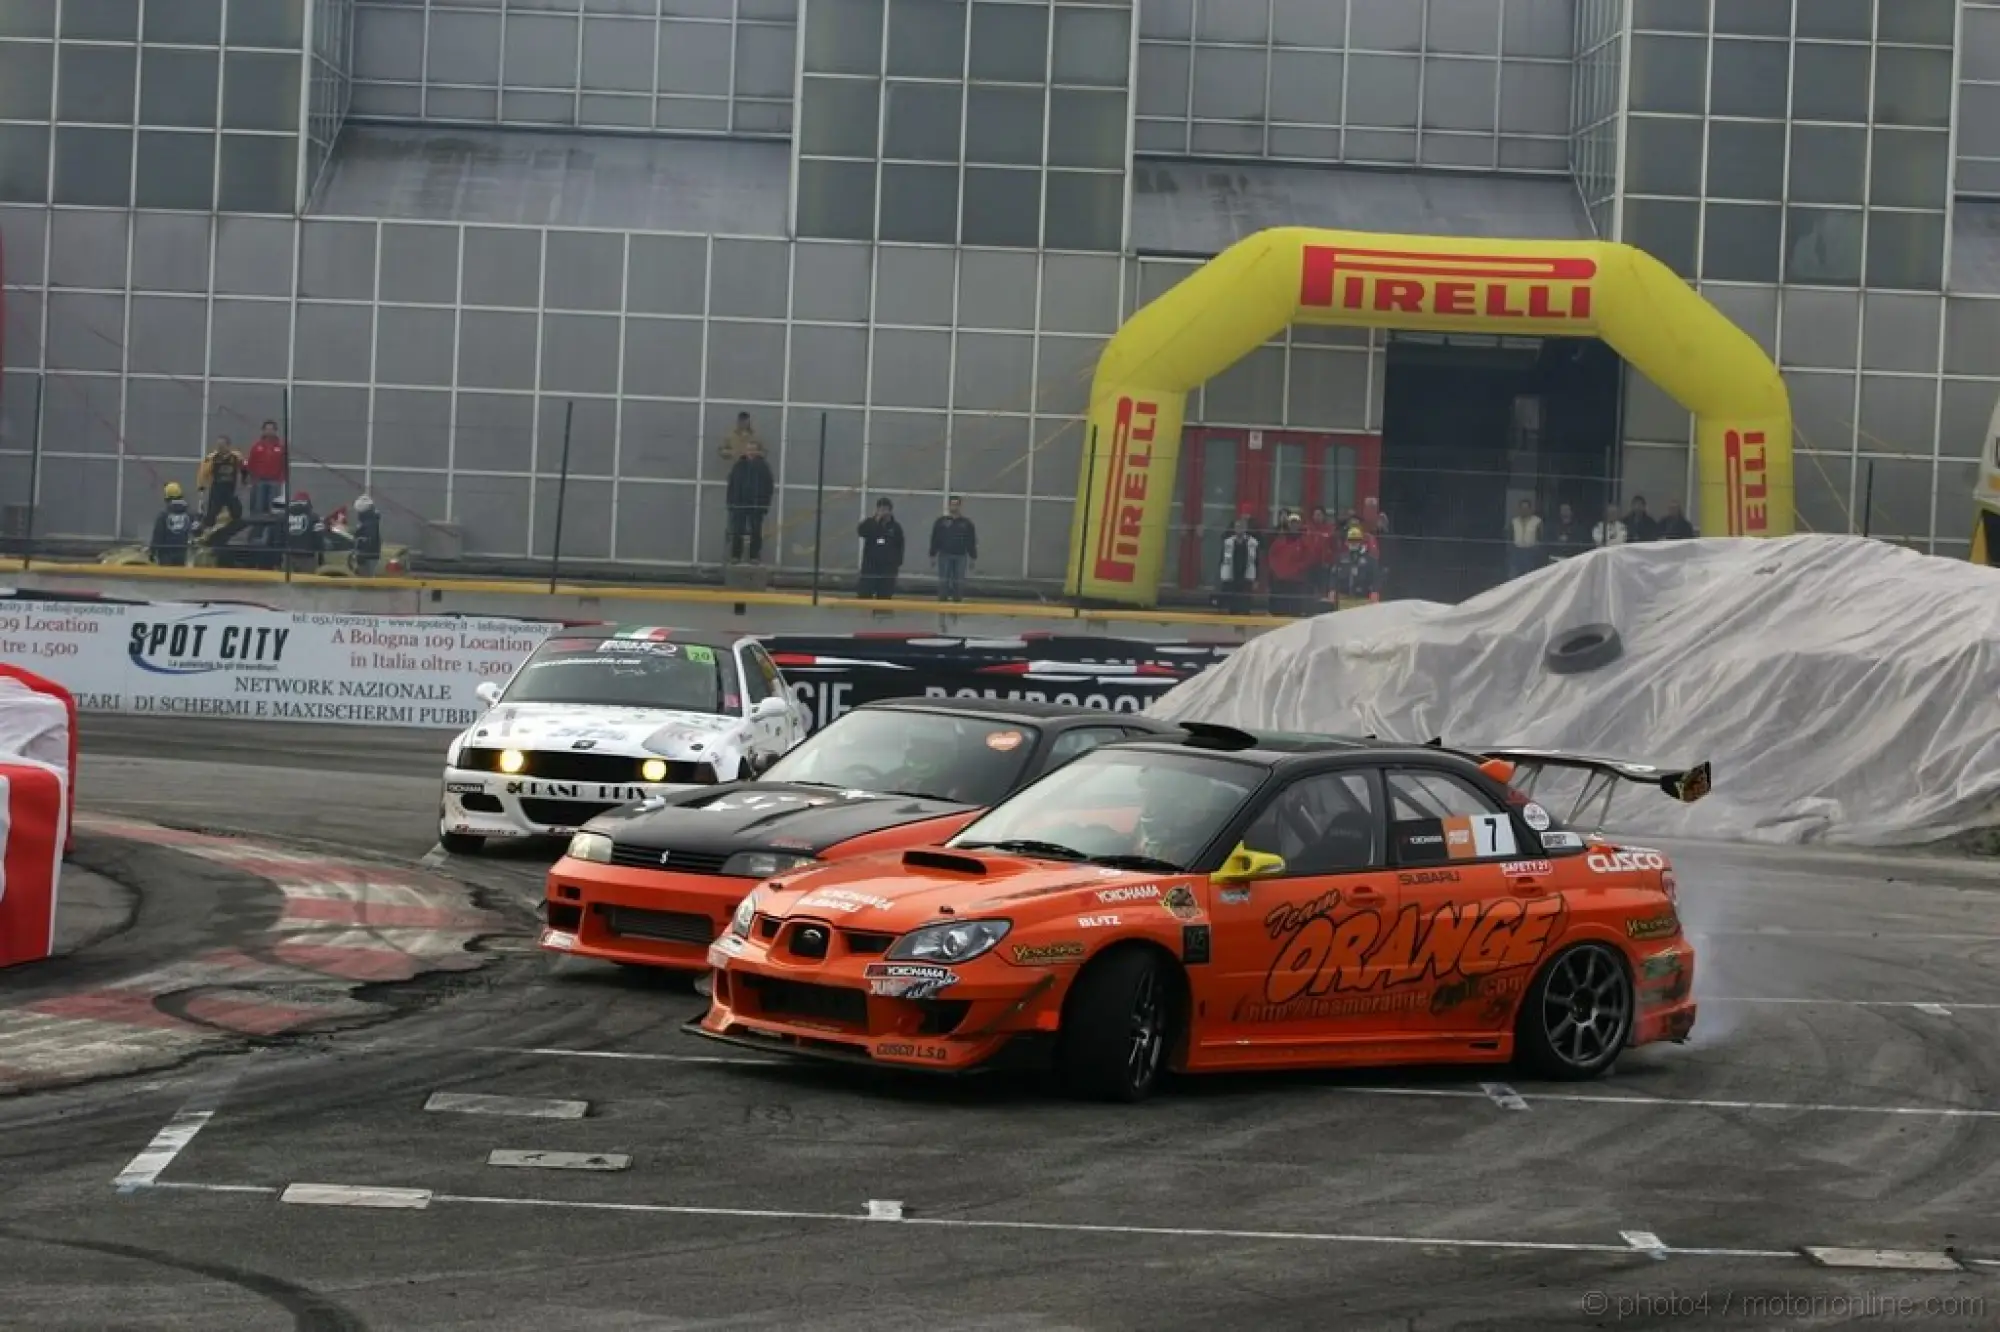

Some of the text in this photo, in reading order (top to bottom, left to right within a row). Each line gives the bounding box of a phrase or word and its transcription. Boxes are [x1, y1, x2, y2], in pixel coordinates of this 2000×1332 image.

[1301, 244, 1597, 319] PIRELLI
[1094, 396, 1158, 582] PIRELLI
[1725, 430, 1767, 537] ELLI
[25, 615, 98, 634] Location
[32, 641, 79, 657] 1.500
[128, 622, 290, 661] SPOT CITY
[331, 628, 532, 652] A Bologna 109 Location
[350, 650, 368, 668] in
[372, 651, 417, 669] Italia
[421, 654, 461, 671] oltre
[467, 660, 513, 676] 1.500
[234, 676, 452, 700] NETWORK NAZIONALE
[134, 694, 154, 712] DI
[159, 696, 249, 716] SCHERMI
[255, 700, 268, 717] E
[272, 700, 414, 722] MAXISCHERMI
[1483, 818, 1497, 852] 7
[1588, 852, 1663, 873] CUSCO
[1399, 870, 1461, 886] SUBARU
[1095, 884, 1161, 904] YOKOHAMA
[1265, 888, 1341, 939] Team
[1264, 893, 1568, 1003] ORANGE
[887, 966, 945, 979] YOKOHAMA
